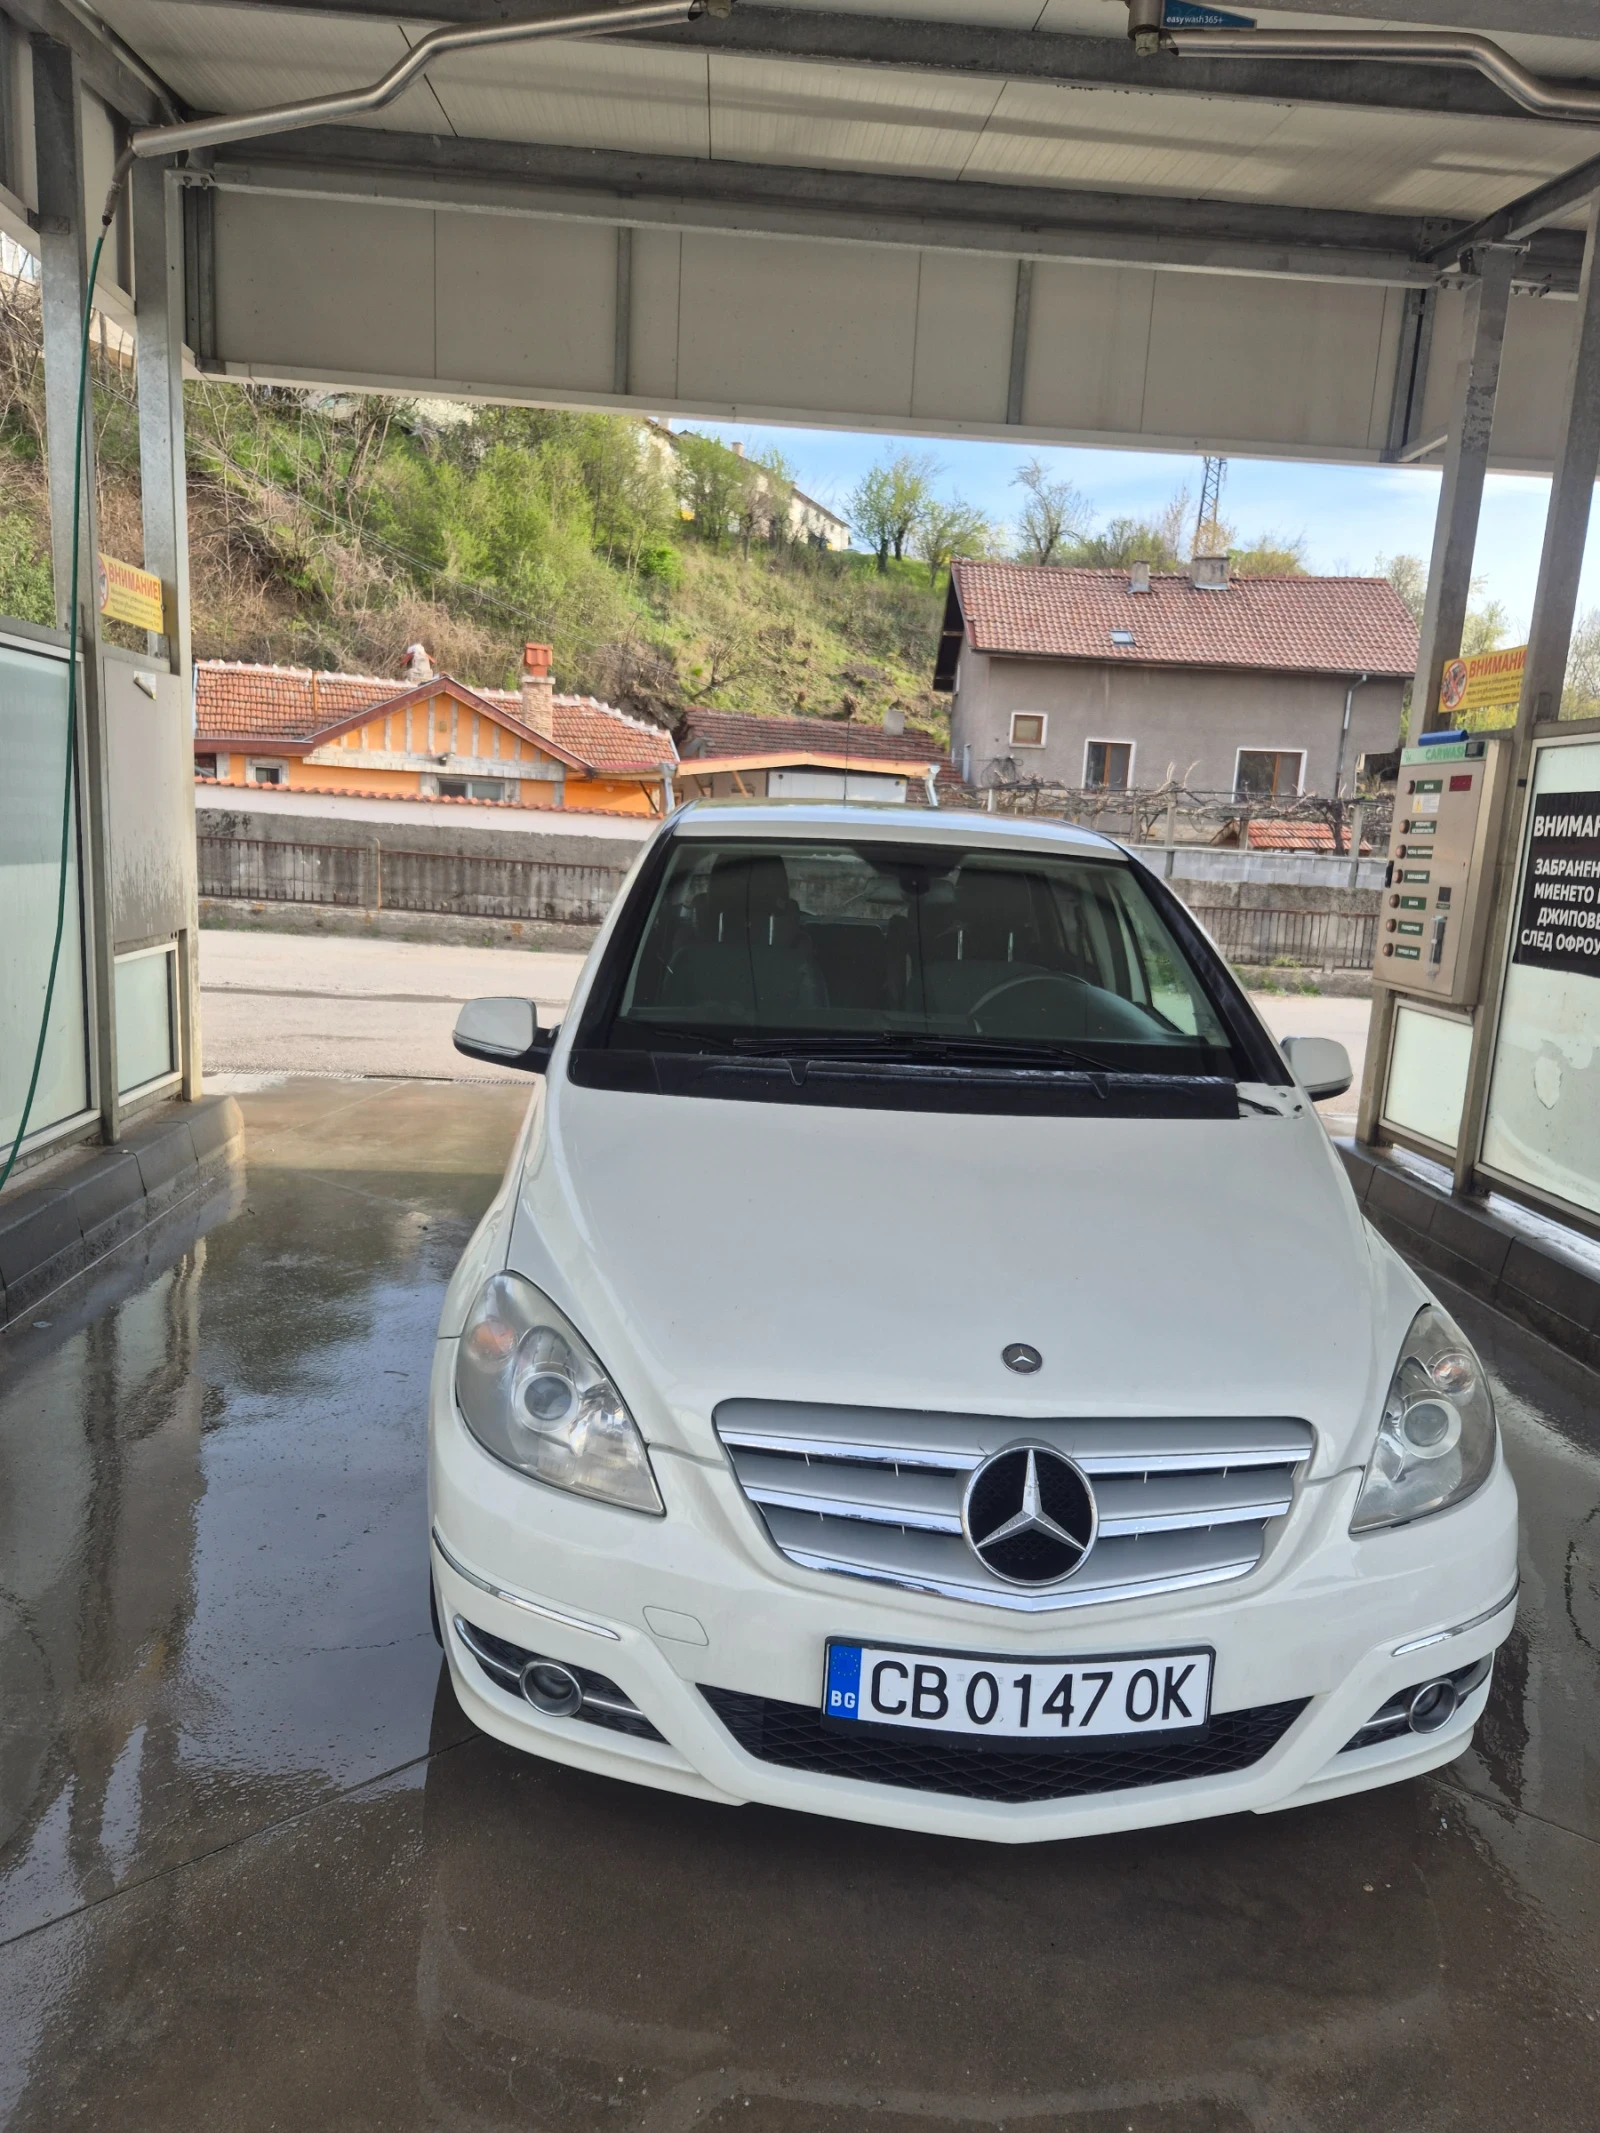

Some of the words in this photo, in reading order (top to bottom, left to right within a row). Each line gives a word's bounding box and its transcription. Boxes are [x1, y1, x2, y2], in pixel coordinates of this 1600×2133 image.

[108, 562, 160, 601] ВНИМАНИЕ!
[1425, 746, 1465, 760] CARWAS
[1533, 882, 1594, 904] МИЕНЕТО
[1521, 929, 1553, 952] СЛЕД
[830, 1690, 856, 1709] BG
[870, 1661, 949, 1720] CB
[965, 1671, 1113, 1728] 0147
[1125, 1664, 1197, 1723] OK
